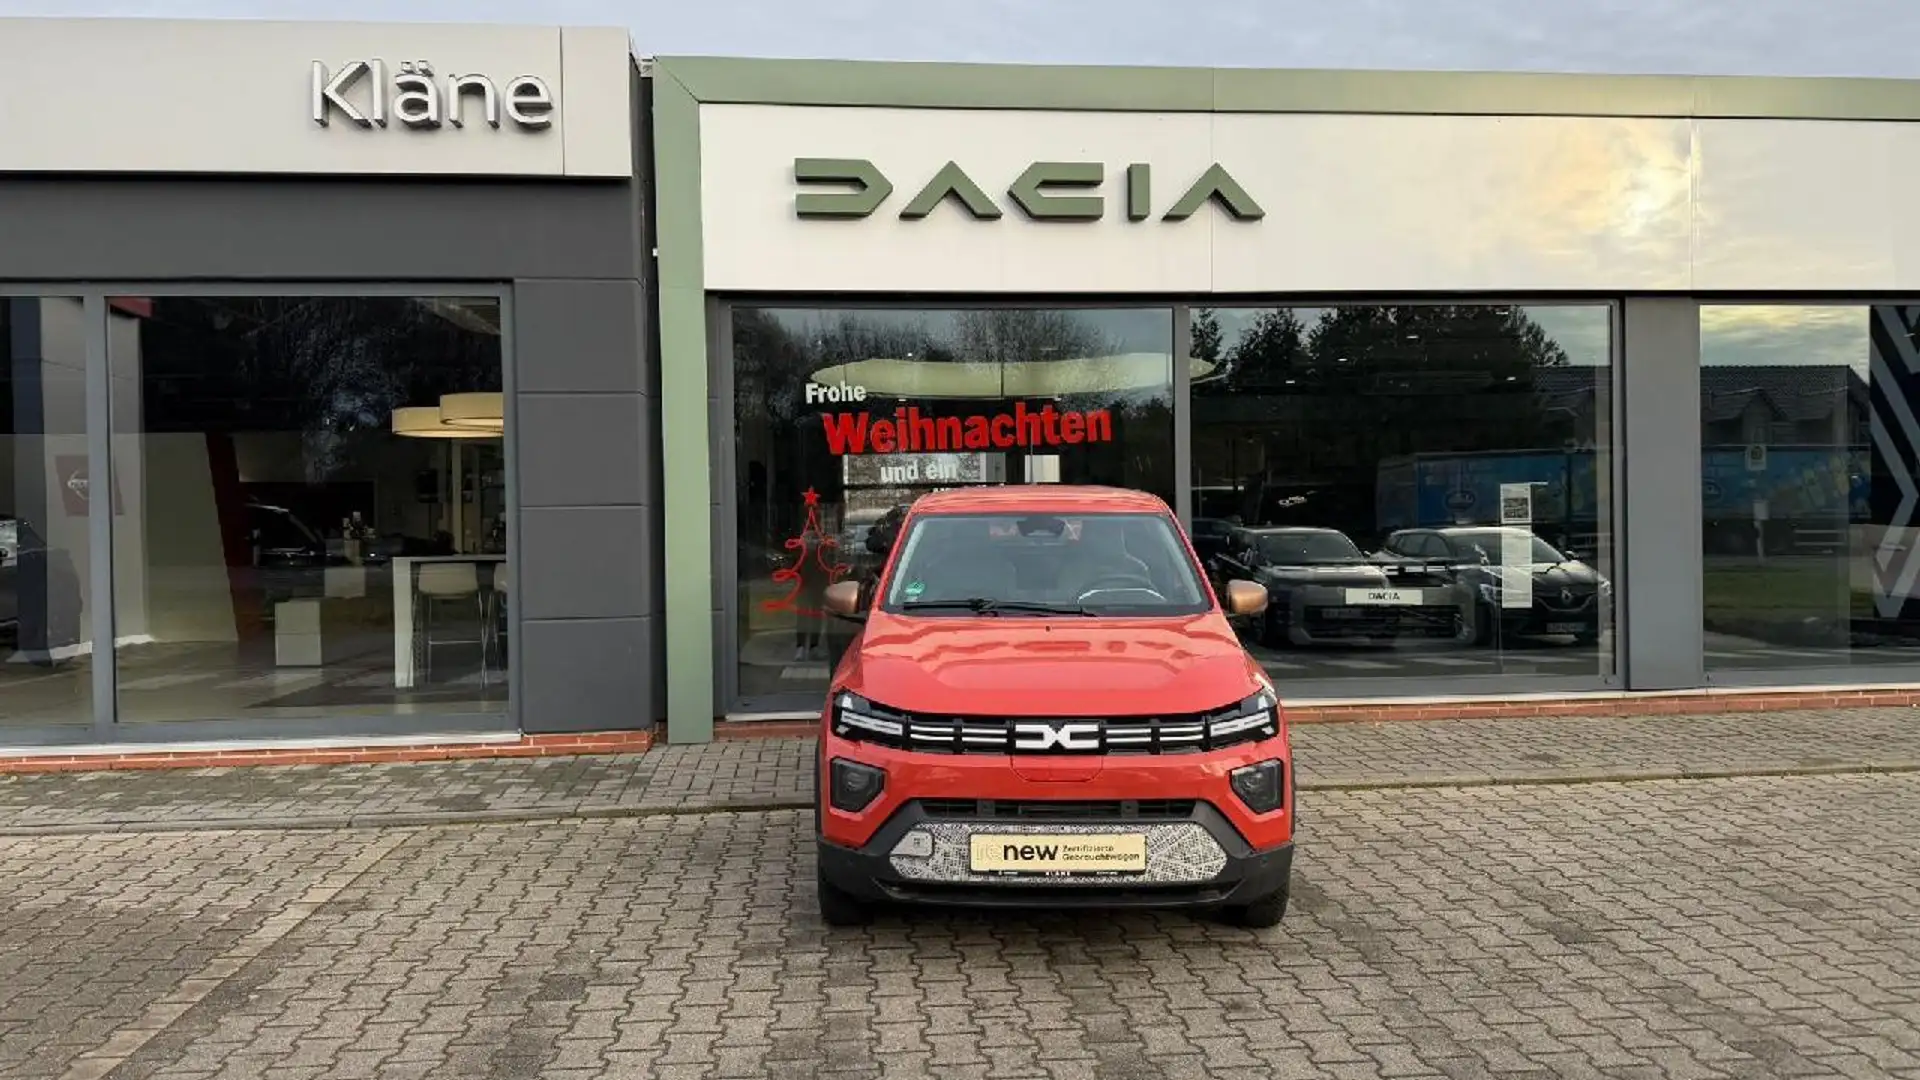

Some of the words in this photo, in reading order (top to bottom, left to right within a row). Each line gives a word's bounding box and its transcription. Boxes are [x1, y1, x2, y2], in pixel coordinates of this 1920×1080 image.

[311, 58, 553, 128] Kläne
[795, 157, 1265, 221] DACIA
[805, 381, 867, 403] Frohe
[822, 402, 1111, 455] Weihnachten
[880, 462, 919, 483] und
[925, 461, 957, 480] ein
[1368, 591, 1401, 600] DACIA
